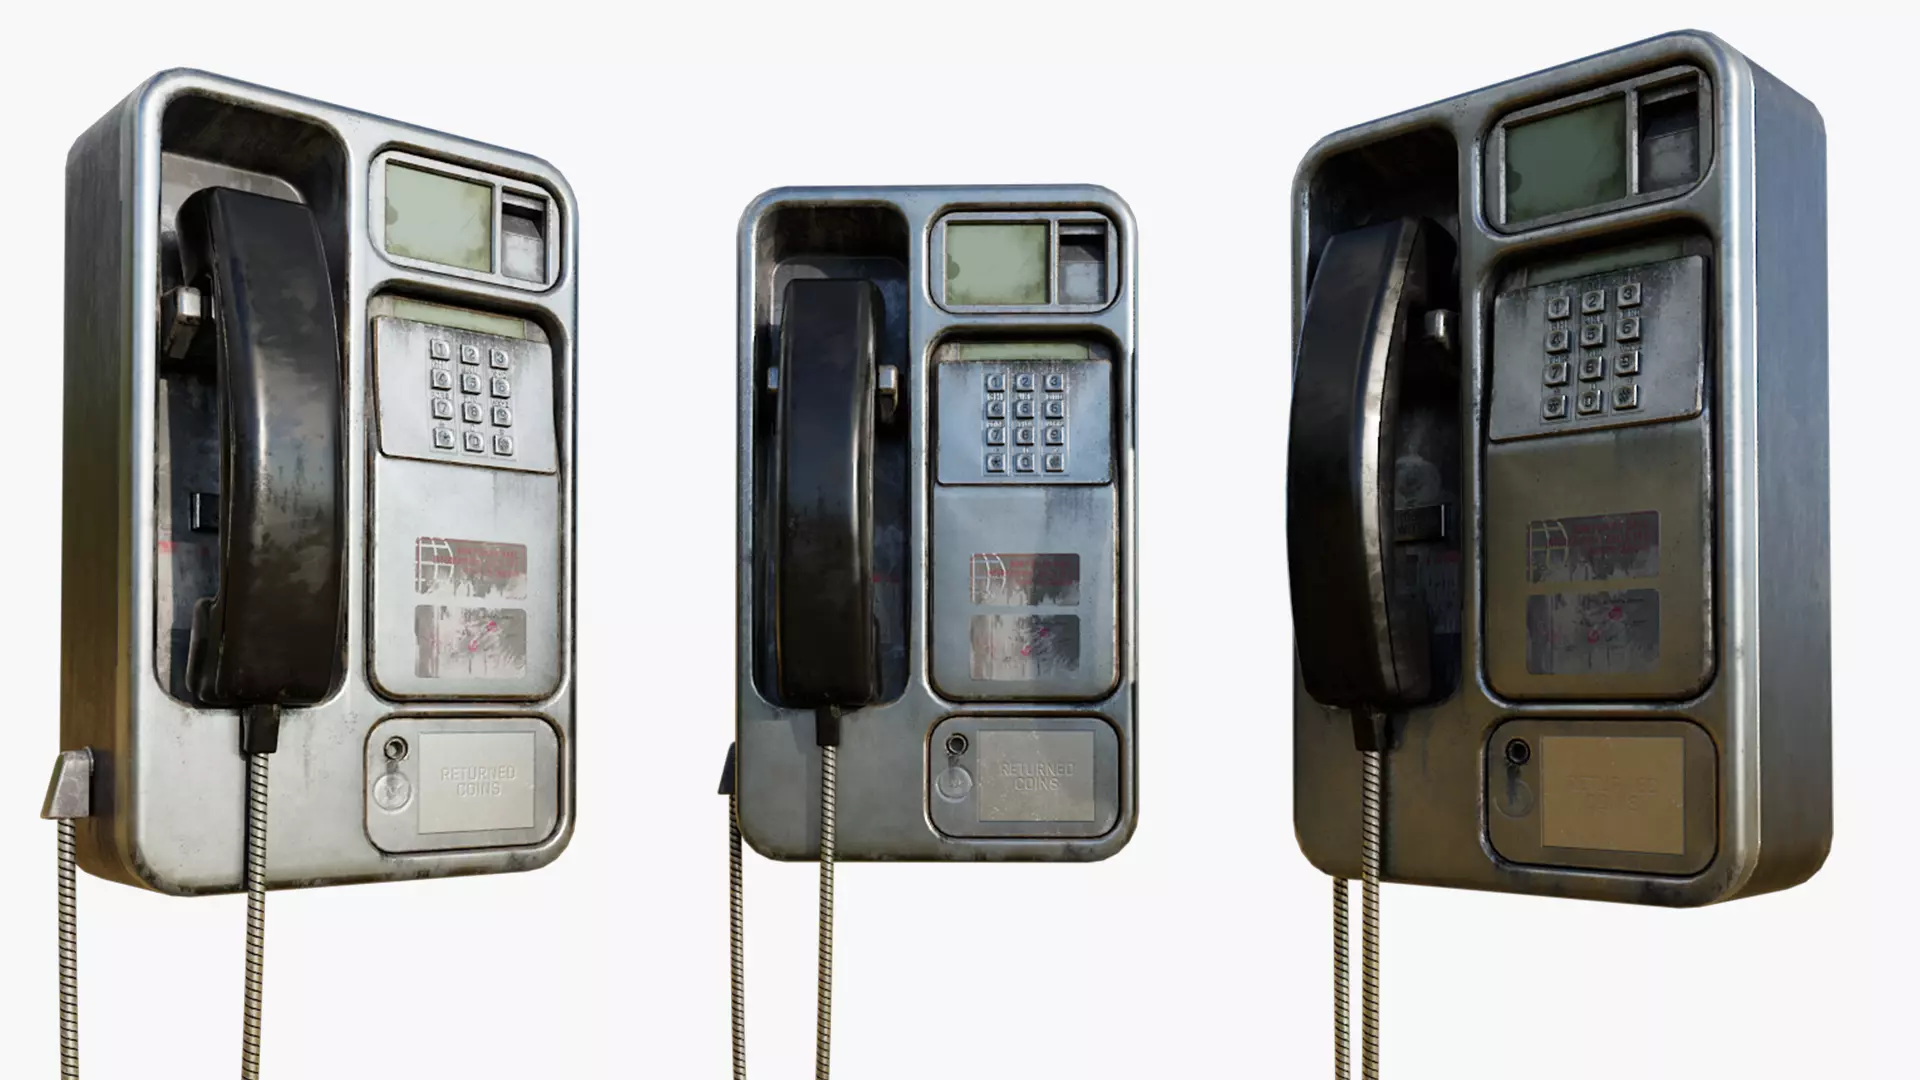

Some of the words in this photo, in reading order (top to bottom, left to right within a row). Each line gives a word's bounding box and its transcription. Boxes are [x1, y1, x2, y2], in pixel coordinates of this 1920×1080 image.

[440, 765, 516, 781] RETURNED
[1001, 762, 1075, 777] RETURNED
[456, 781, 501, 796] COINS
[1014, 776, 1060, 791] COINS
